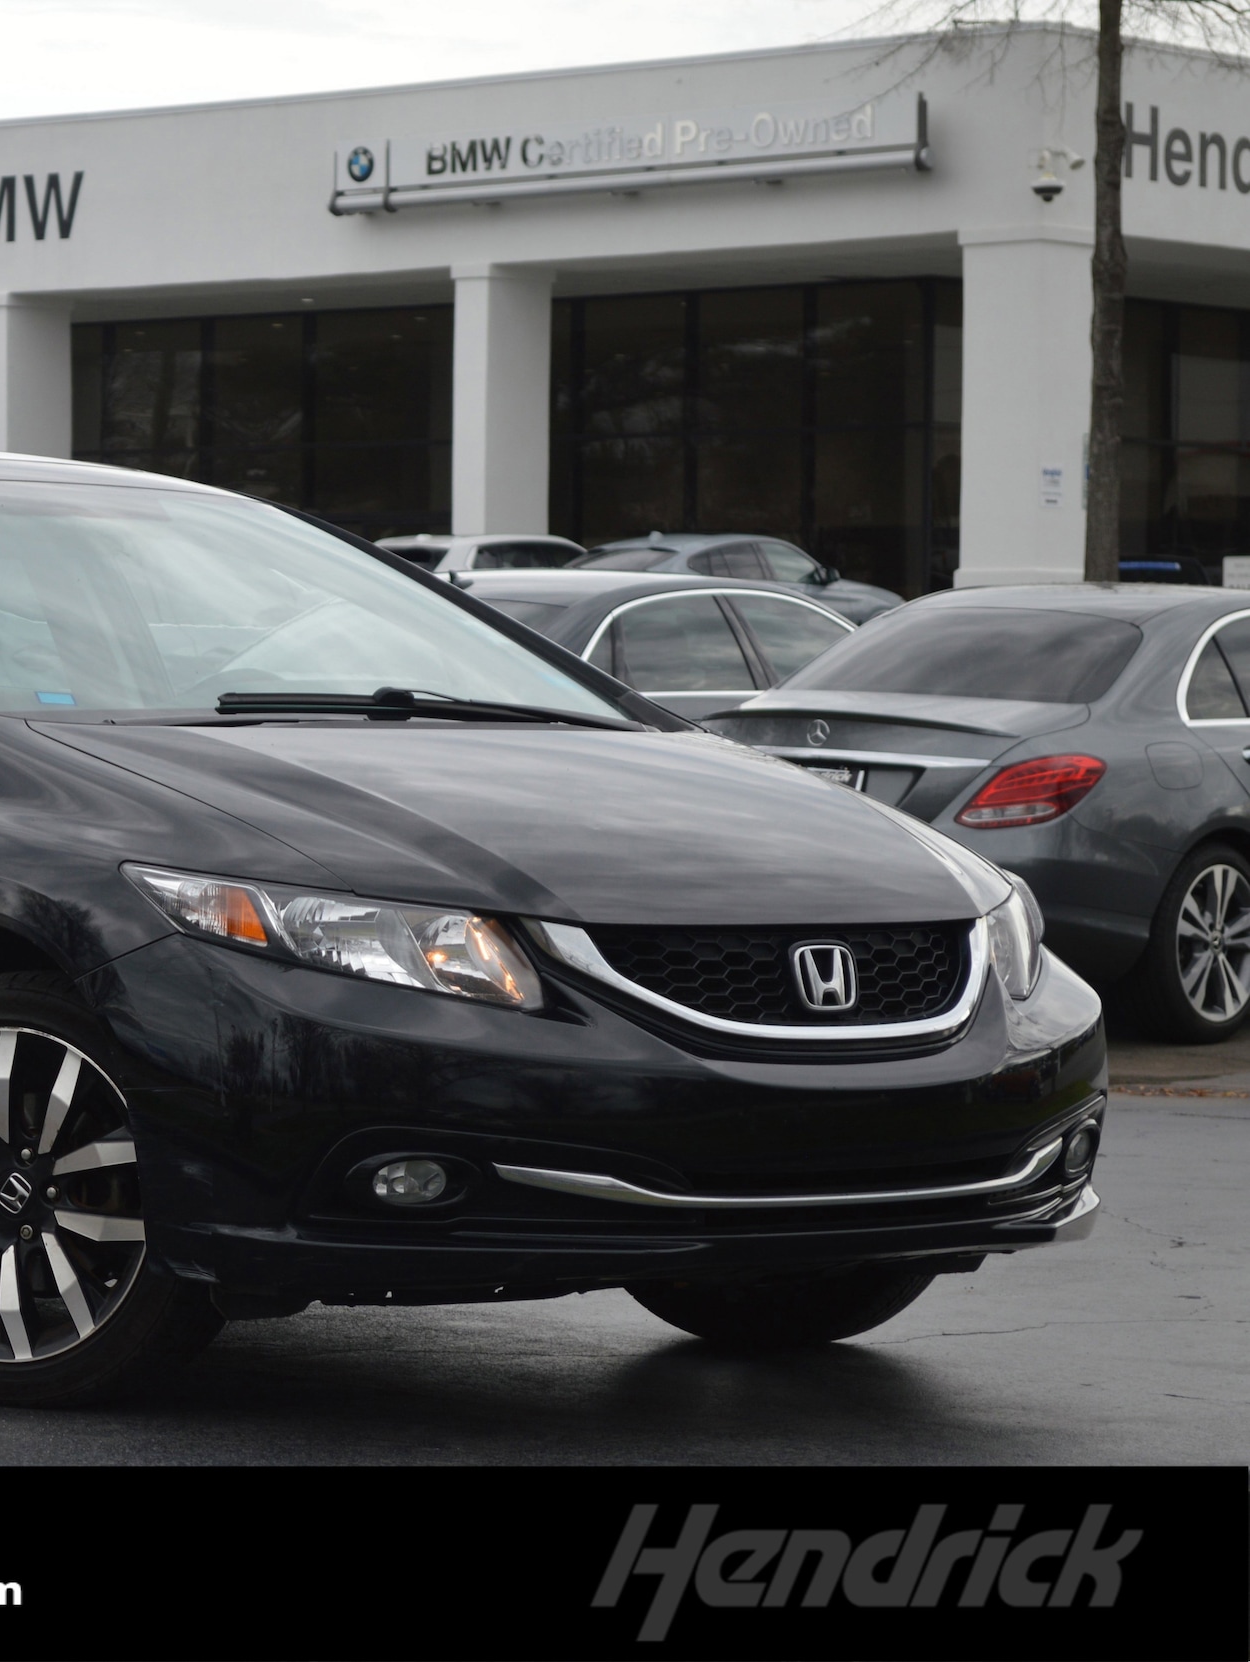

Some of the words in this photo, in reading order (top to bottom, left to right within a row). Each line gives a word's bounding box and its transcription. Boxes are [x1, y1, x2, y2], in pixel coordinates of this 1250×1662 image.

[425, 135, 513, 176] BMW
[519, 121, 665, 170] Certified
[674, 103, 876, 156] Pre-Owned
